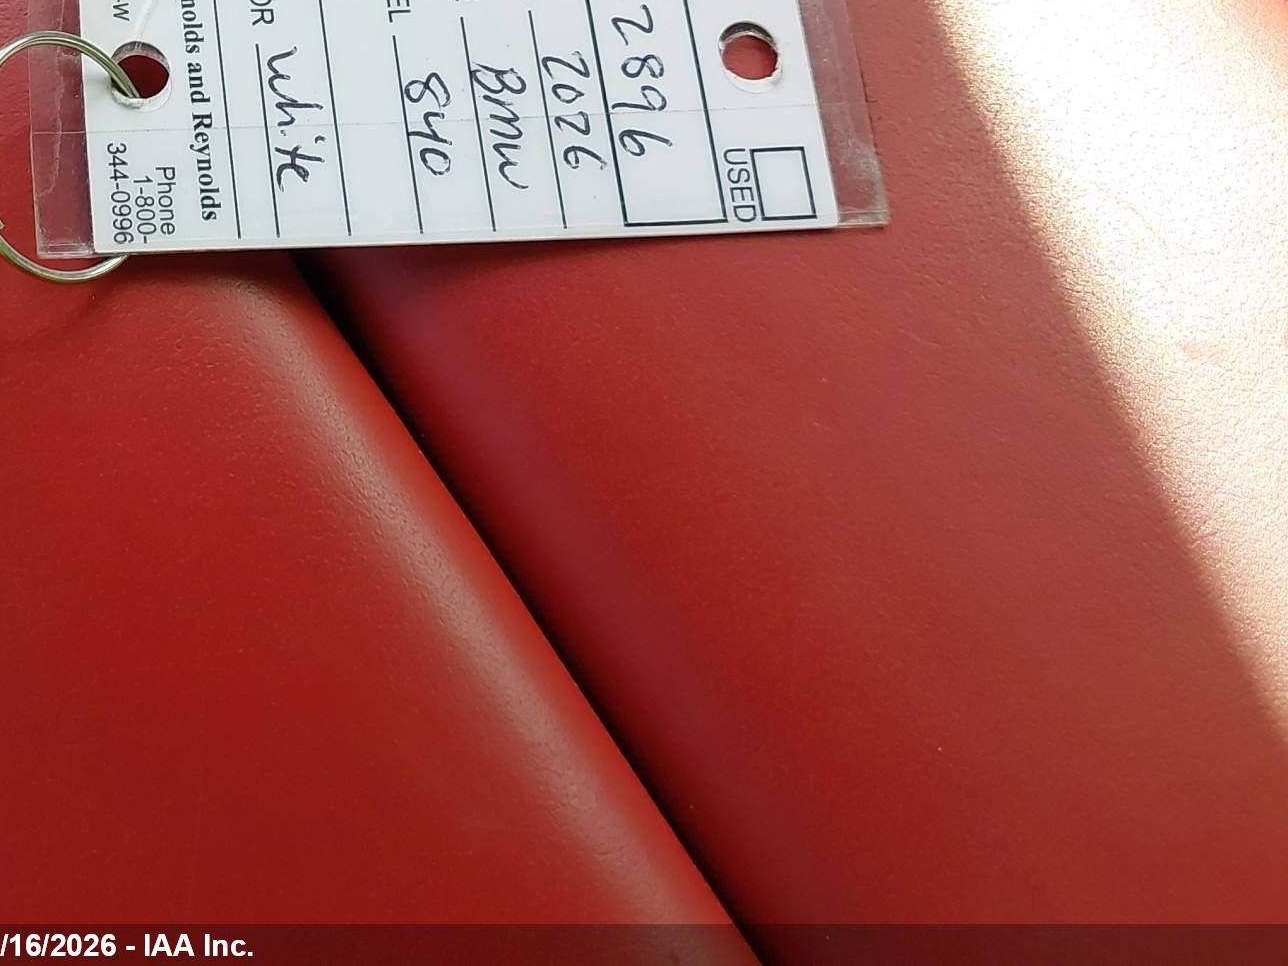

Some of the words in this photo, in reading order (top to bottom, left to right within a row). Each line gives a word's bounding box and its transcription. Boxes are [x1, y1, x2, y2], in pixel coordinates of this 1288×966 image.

[187, 62, 210, 104] and
[403, 72, 453, 175] 840
[541, 50, 608, 170] 2026
[107, 142, 134, 245] 344-0996
[133, 175, 158, 244] 1-800-
[155, 166, 177, 235] Phone
[189, 112, 222, 221] Reynolds
[723, 148, 757, 223] USED
